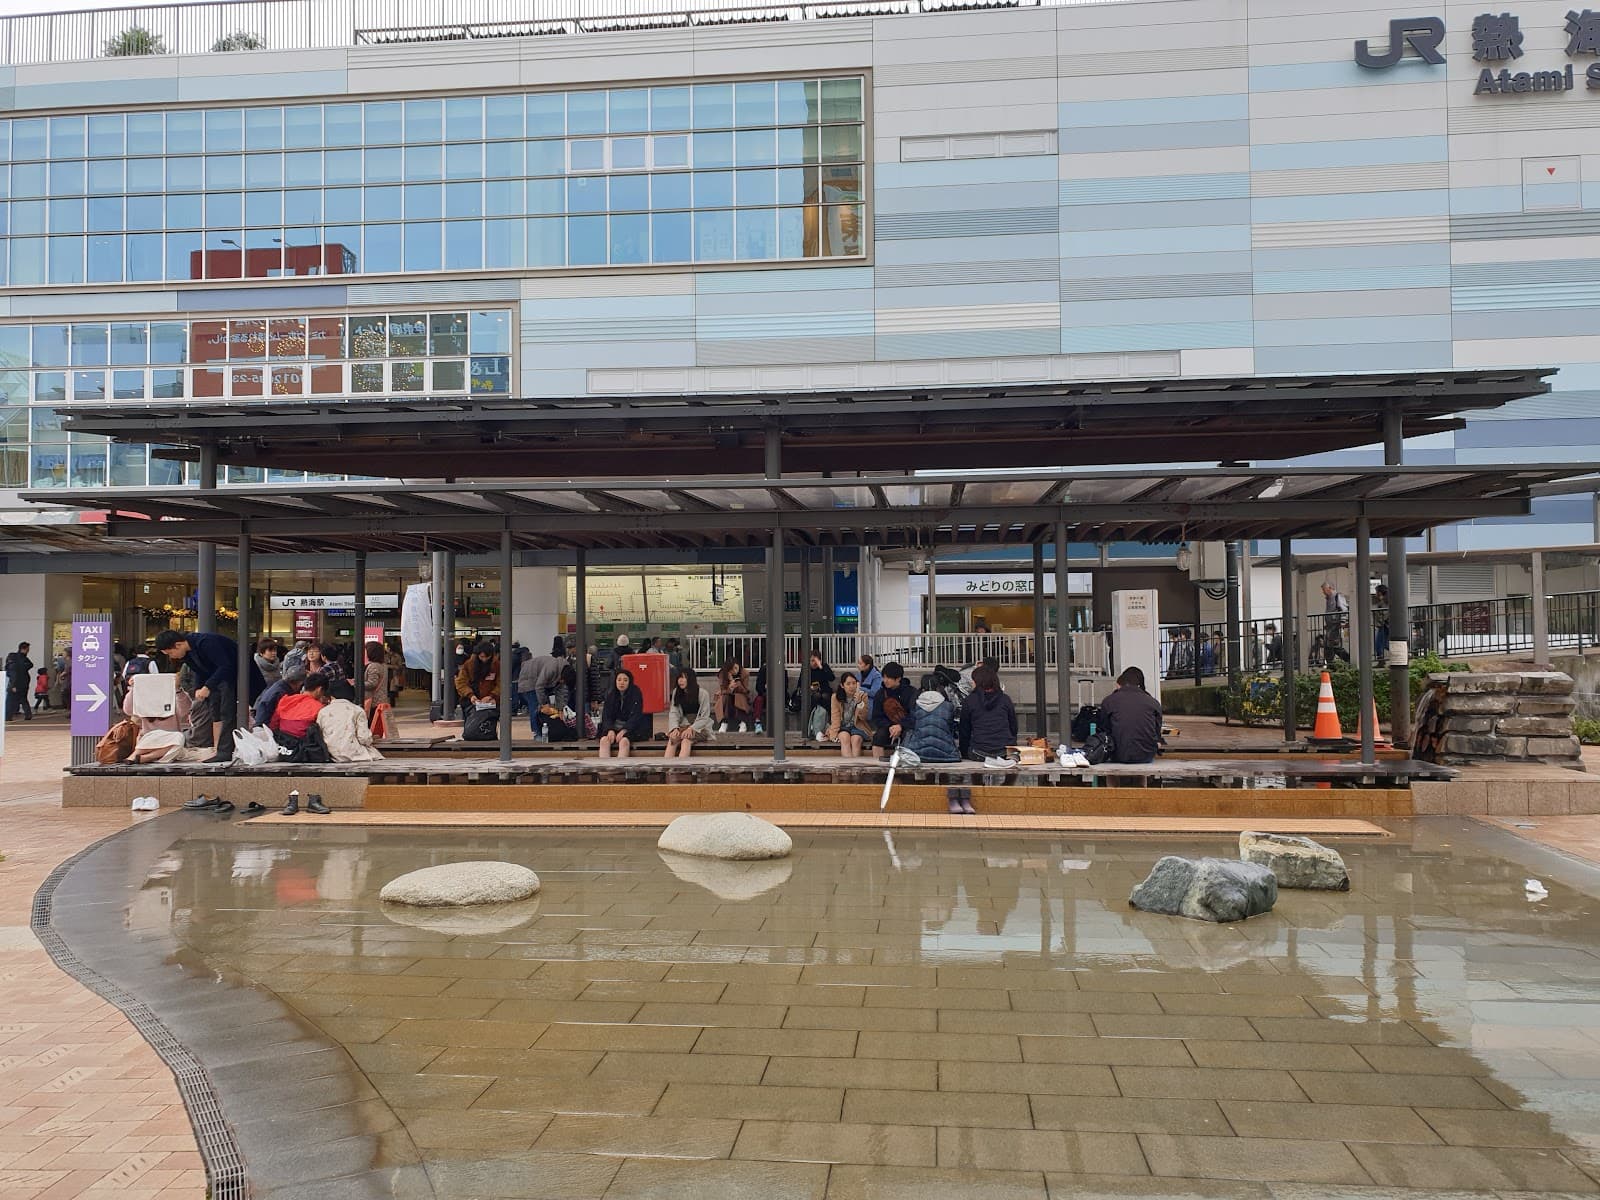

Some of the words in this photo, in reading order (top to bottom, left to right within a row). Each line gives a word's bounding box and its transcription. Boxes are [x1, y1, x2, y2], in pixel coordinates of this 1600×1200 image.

[1354, 16, 1447, 69] JR
[1473, 64, 1573, 95] Atami
[282, 598, 296, 606] JR
[300, 598, 325, 607] 熱海駅
